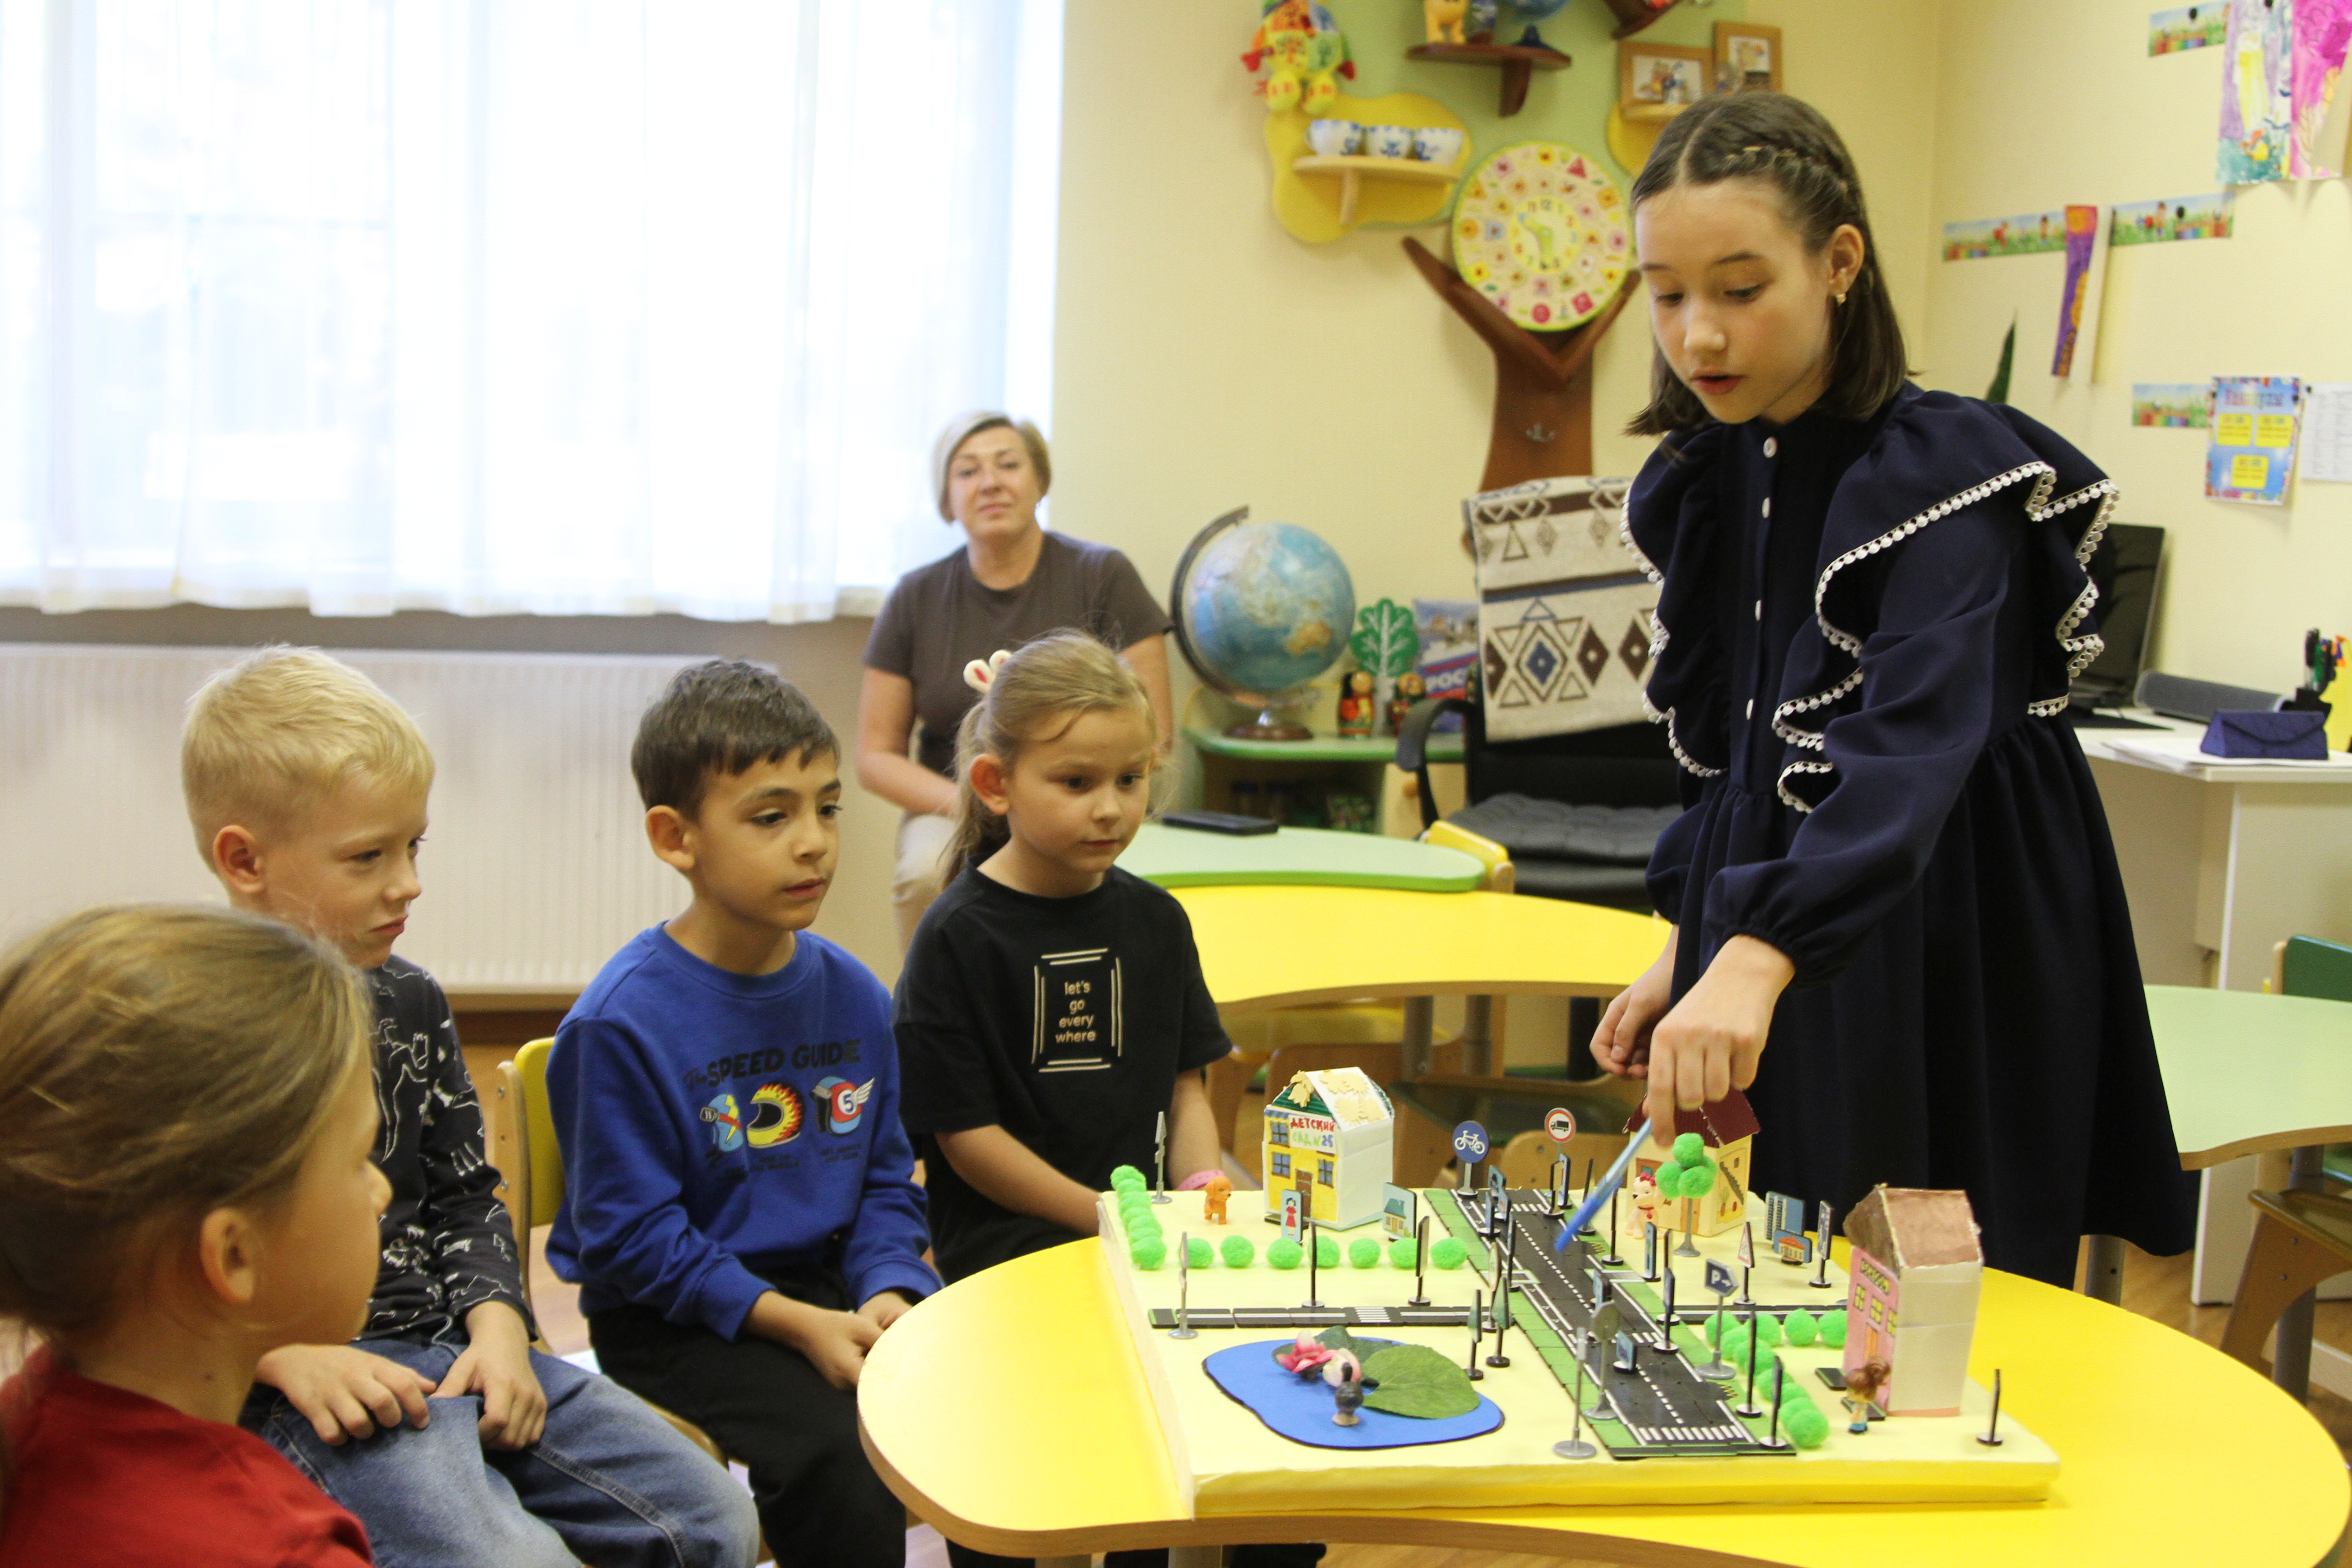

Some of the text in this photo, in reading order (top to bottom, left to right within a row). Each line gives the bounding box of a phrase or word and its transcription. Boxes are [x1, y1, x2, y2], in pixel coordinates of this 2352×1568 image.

[1064, 980, 1091, 995] let's
[1069, 999, 1085, 1014] go
[1058, 1014, 1094, 1029] every
[1055, 1030, 1097, 1043] where
[706, 1048, 785, 1088] SPEED
[792, 1039, 861, 1070] GUIDE
[843, 1093, 854, 1113] 5
[1290, 1117, 1336, 1132] ДЕТСКИЙ
[1711, 1269, 1721, 1284] P
